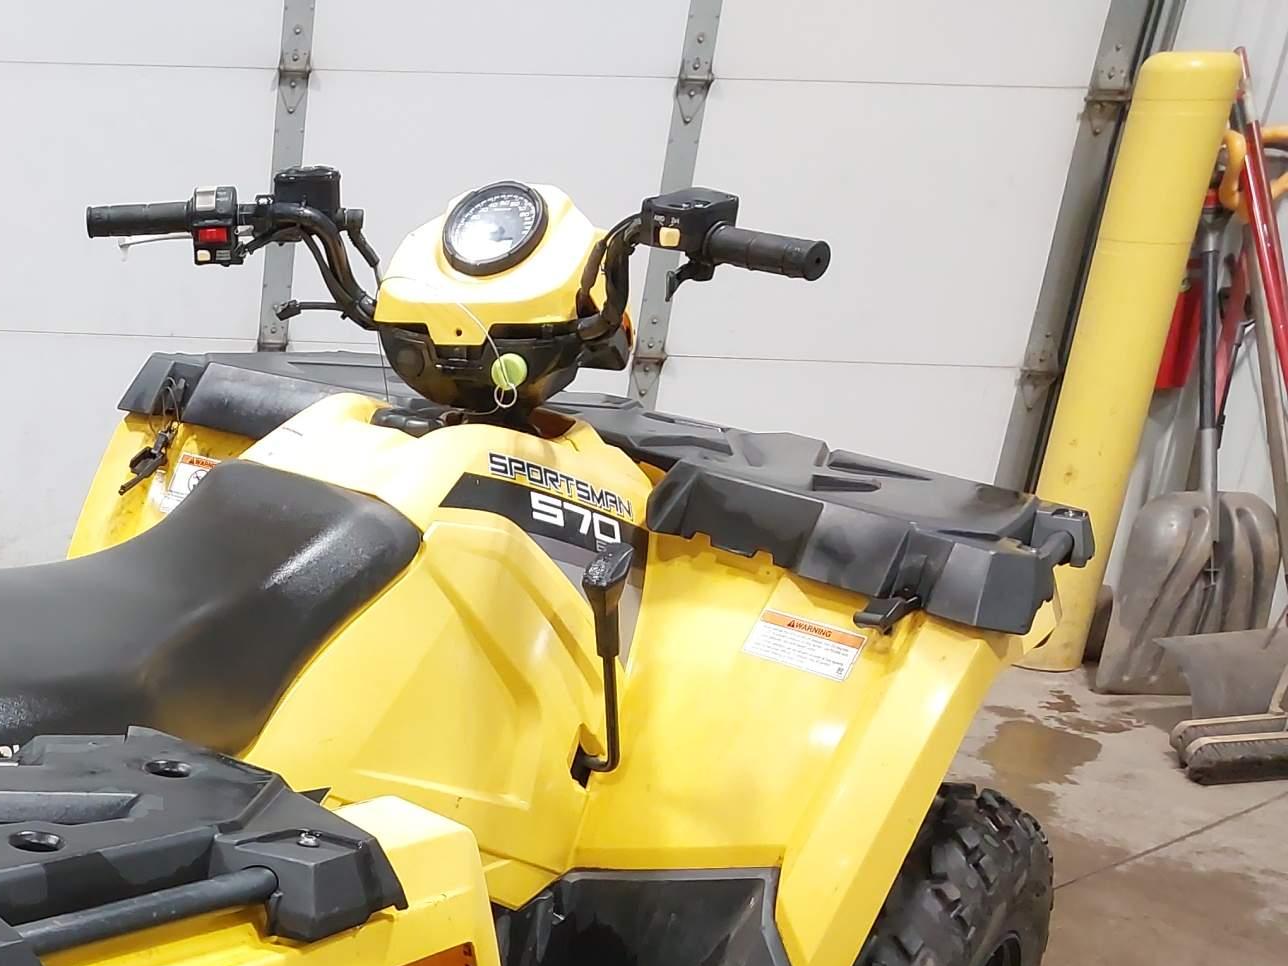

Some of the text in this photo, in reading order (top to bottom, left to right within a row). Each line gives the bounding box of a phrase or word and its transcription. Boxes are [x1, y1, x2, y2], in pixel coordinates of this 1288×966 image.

[488, 452, 633, 521] SPORTSMAN
[529, 491, 621, 544] 570
[795, 621, 833, 638] WARNING
